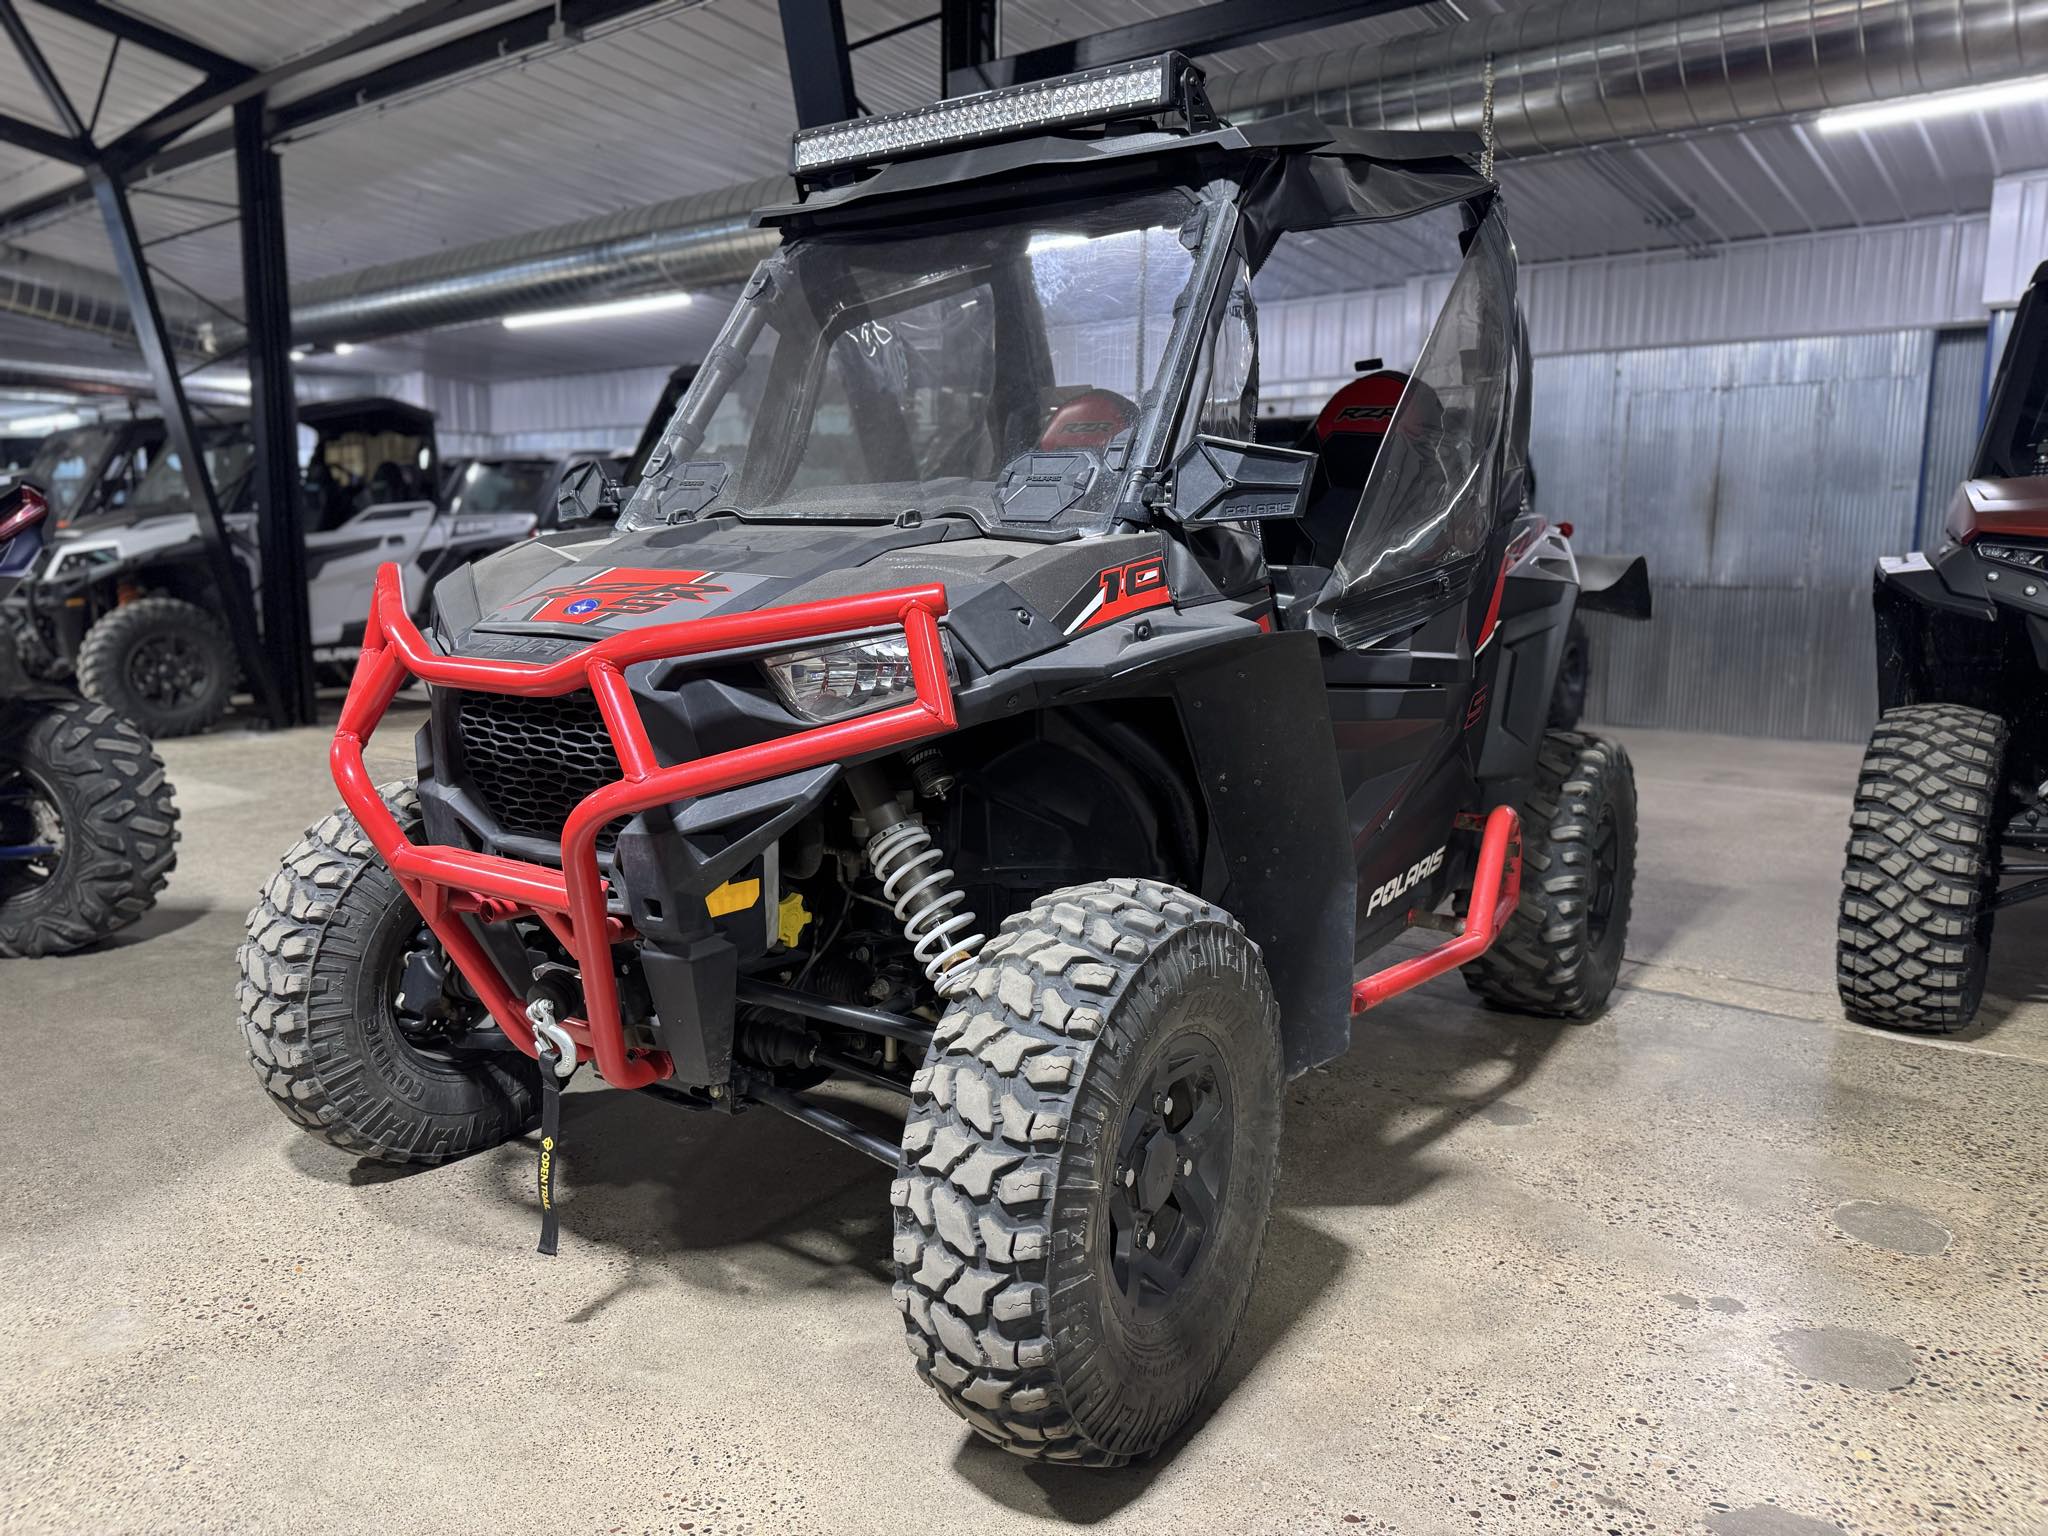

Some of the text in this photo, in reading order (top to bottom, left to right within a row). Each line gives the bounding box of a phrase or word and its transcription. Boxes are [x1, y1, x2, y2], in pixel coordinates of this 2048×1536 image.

[1058, 422, 1113, 434] RZR
[1225, 502, 1294, 517] POLARIS
[1366, 845, 1447, 918] POLARIS
[540, 1151, 551, 1184] OPEN
